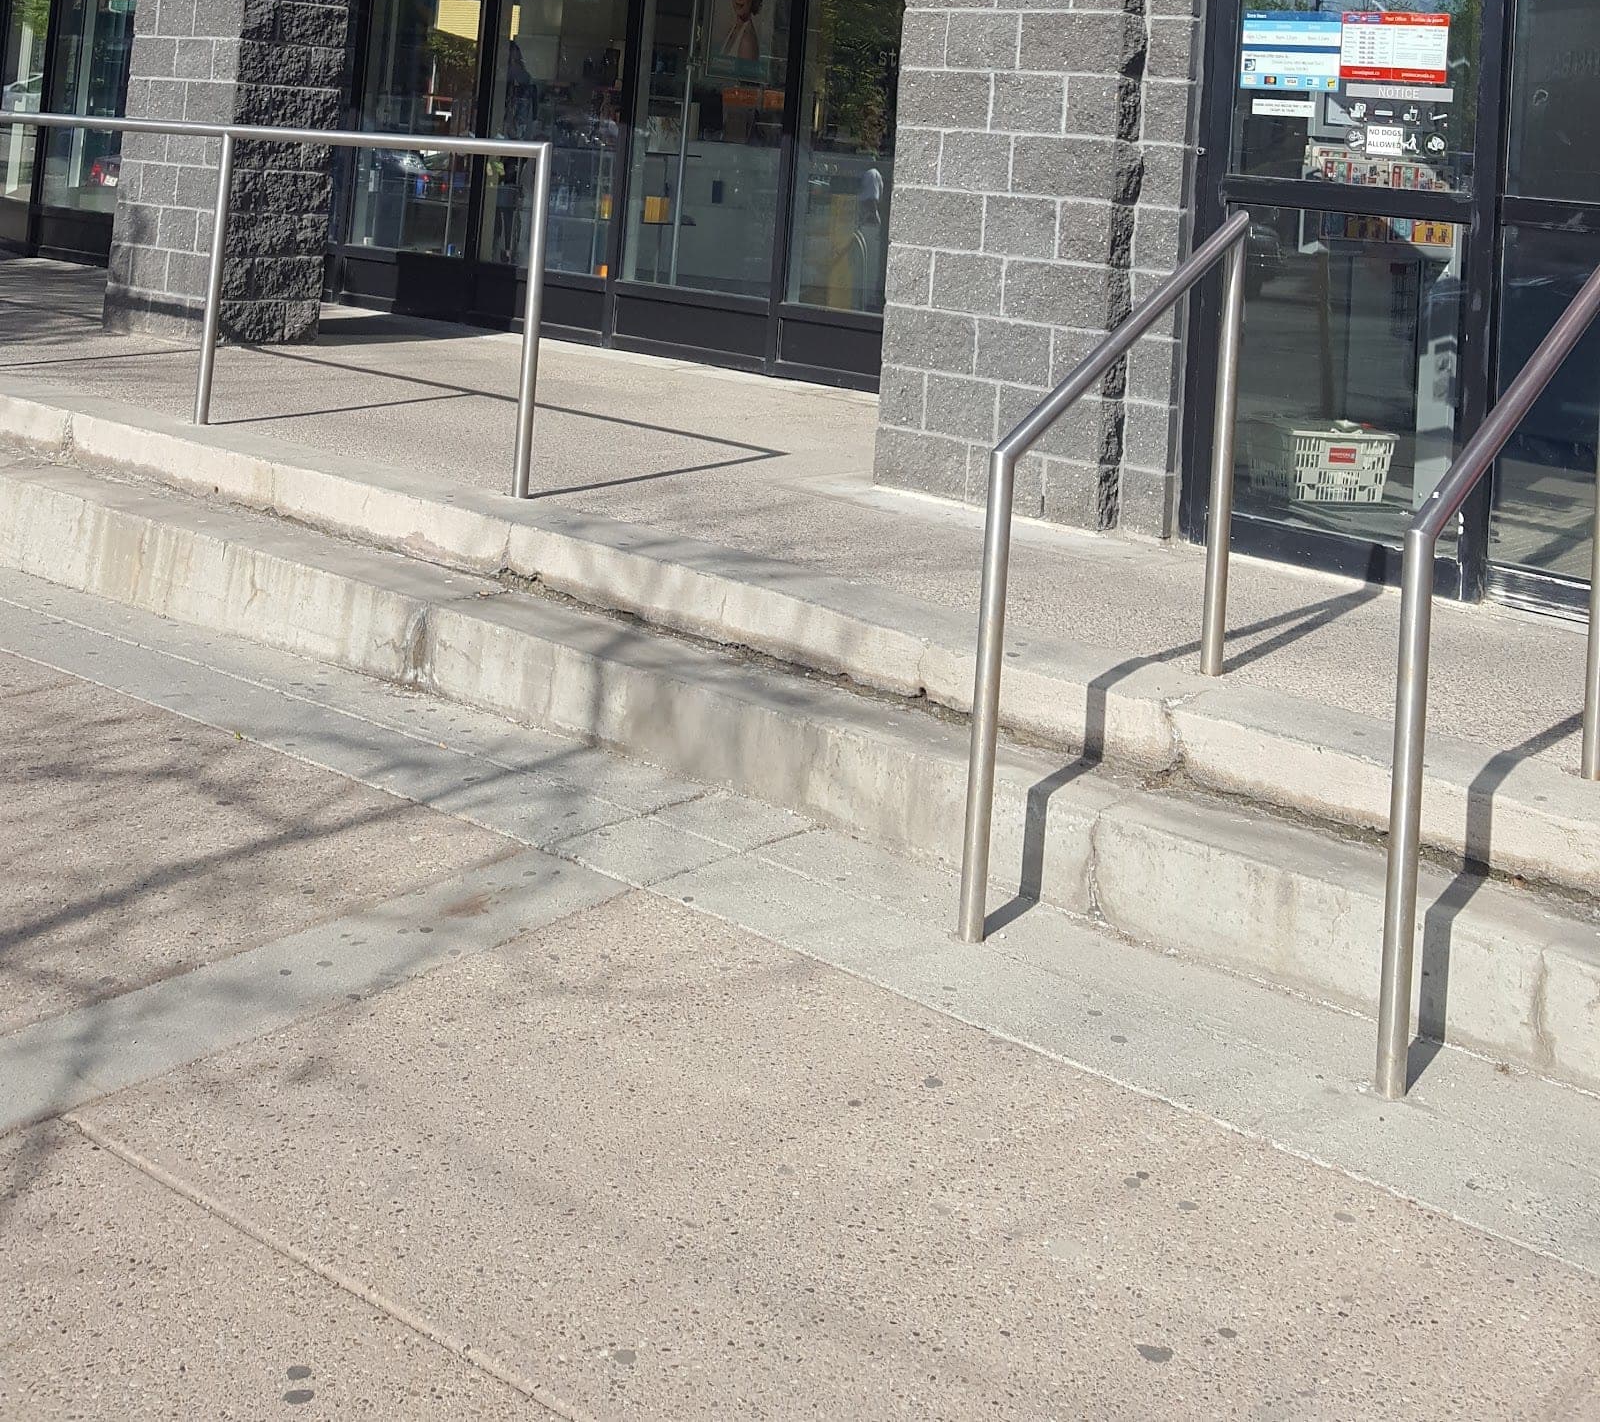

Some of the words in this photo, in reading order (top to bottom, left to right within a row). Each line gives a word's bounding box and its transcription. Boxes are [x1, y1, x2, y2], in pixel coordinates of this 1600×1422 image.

[1377, 86, 1420, 99] NOTICE
[1368, 128, 1380, 136] NO
[1381, 129, 1402, 137] DOGS
[1367, 140, 1402, 149] ALLOWED
